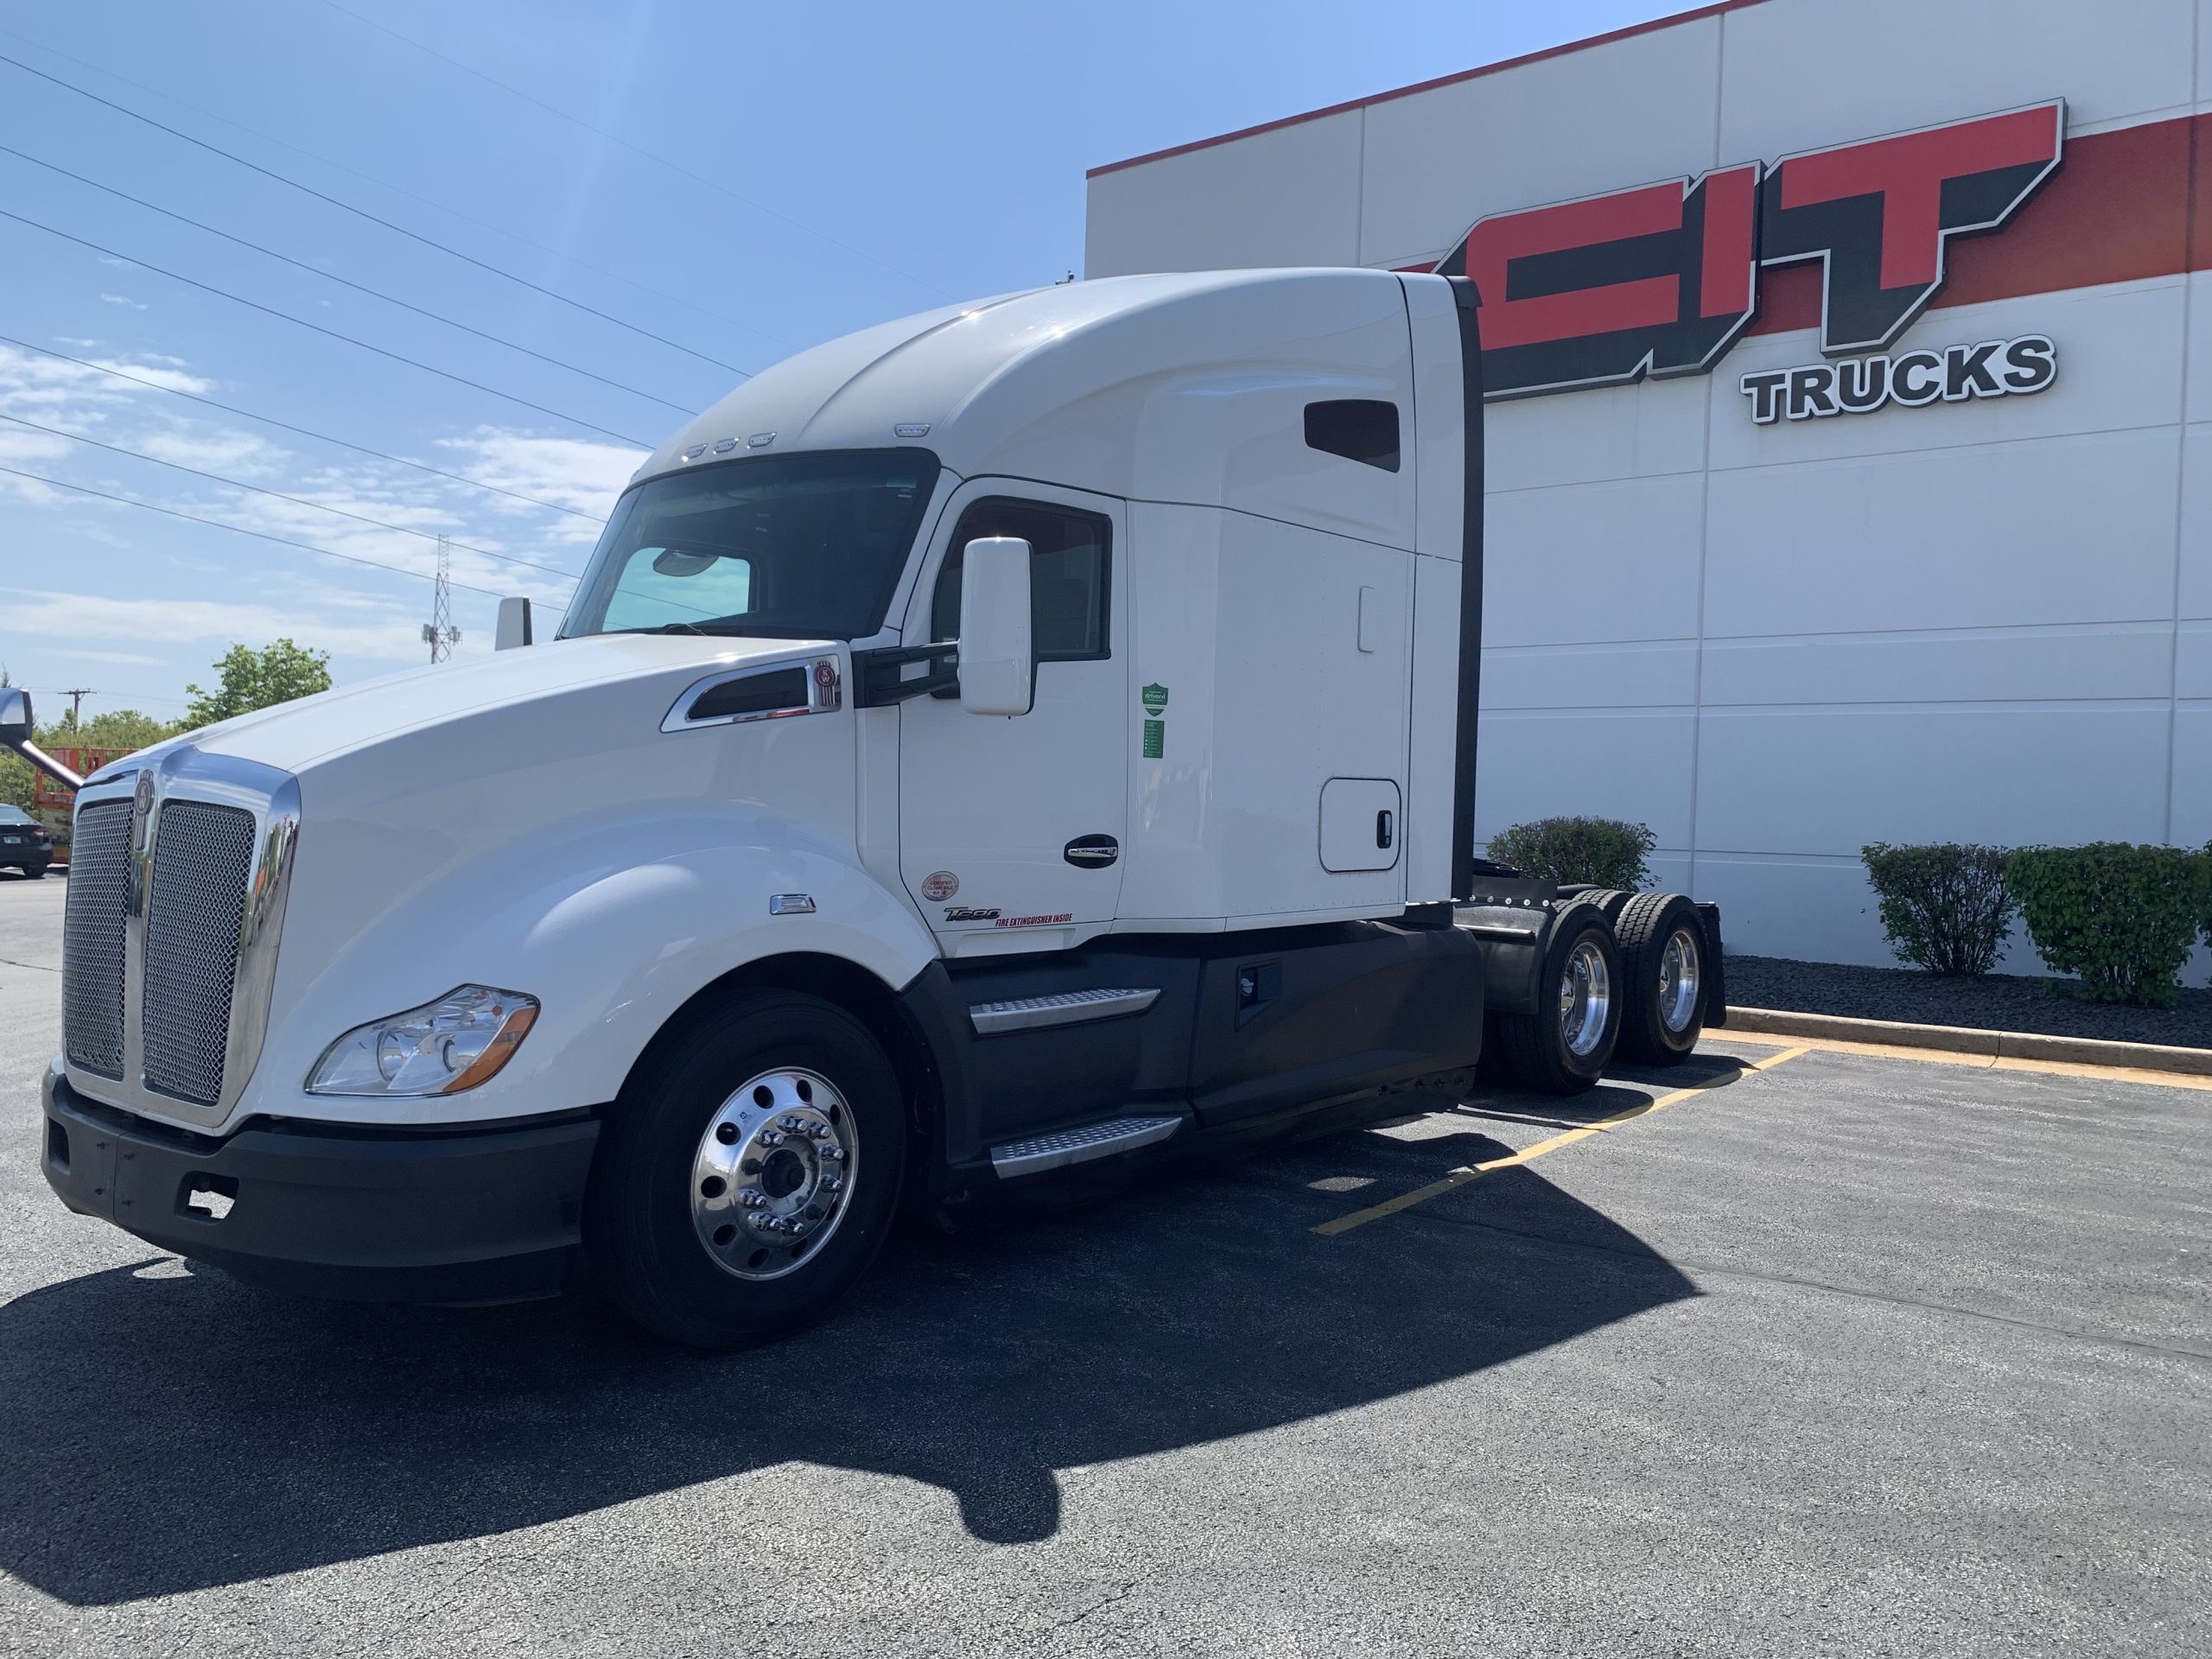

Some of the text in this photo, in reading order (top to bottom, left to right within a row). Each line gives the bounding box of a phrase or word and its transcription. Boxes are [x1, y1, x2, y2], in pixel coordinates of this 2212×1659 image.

[1740, 336, 2056, 424] TRUCKS
[995, 913, 1072, 927] FIRE EXTINGUISHER INSIDE
